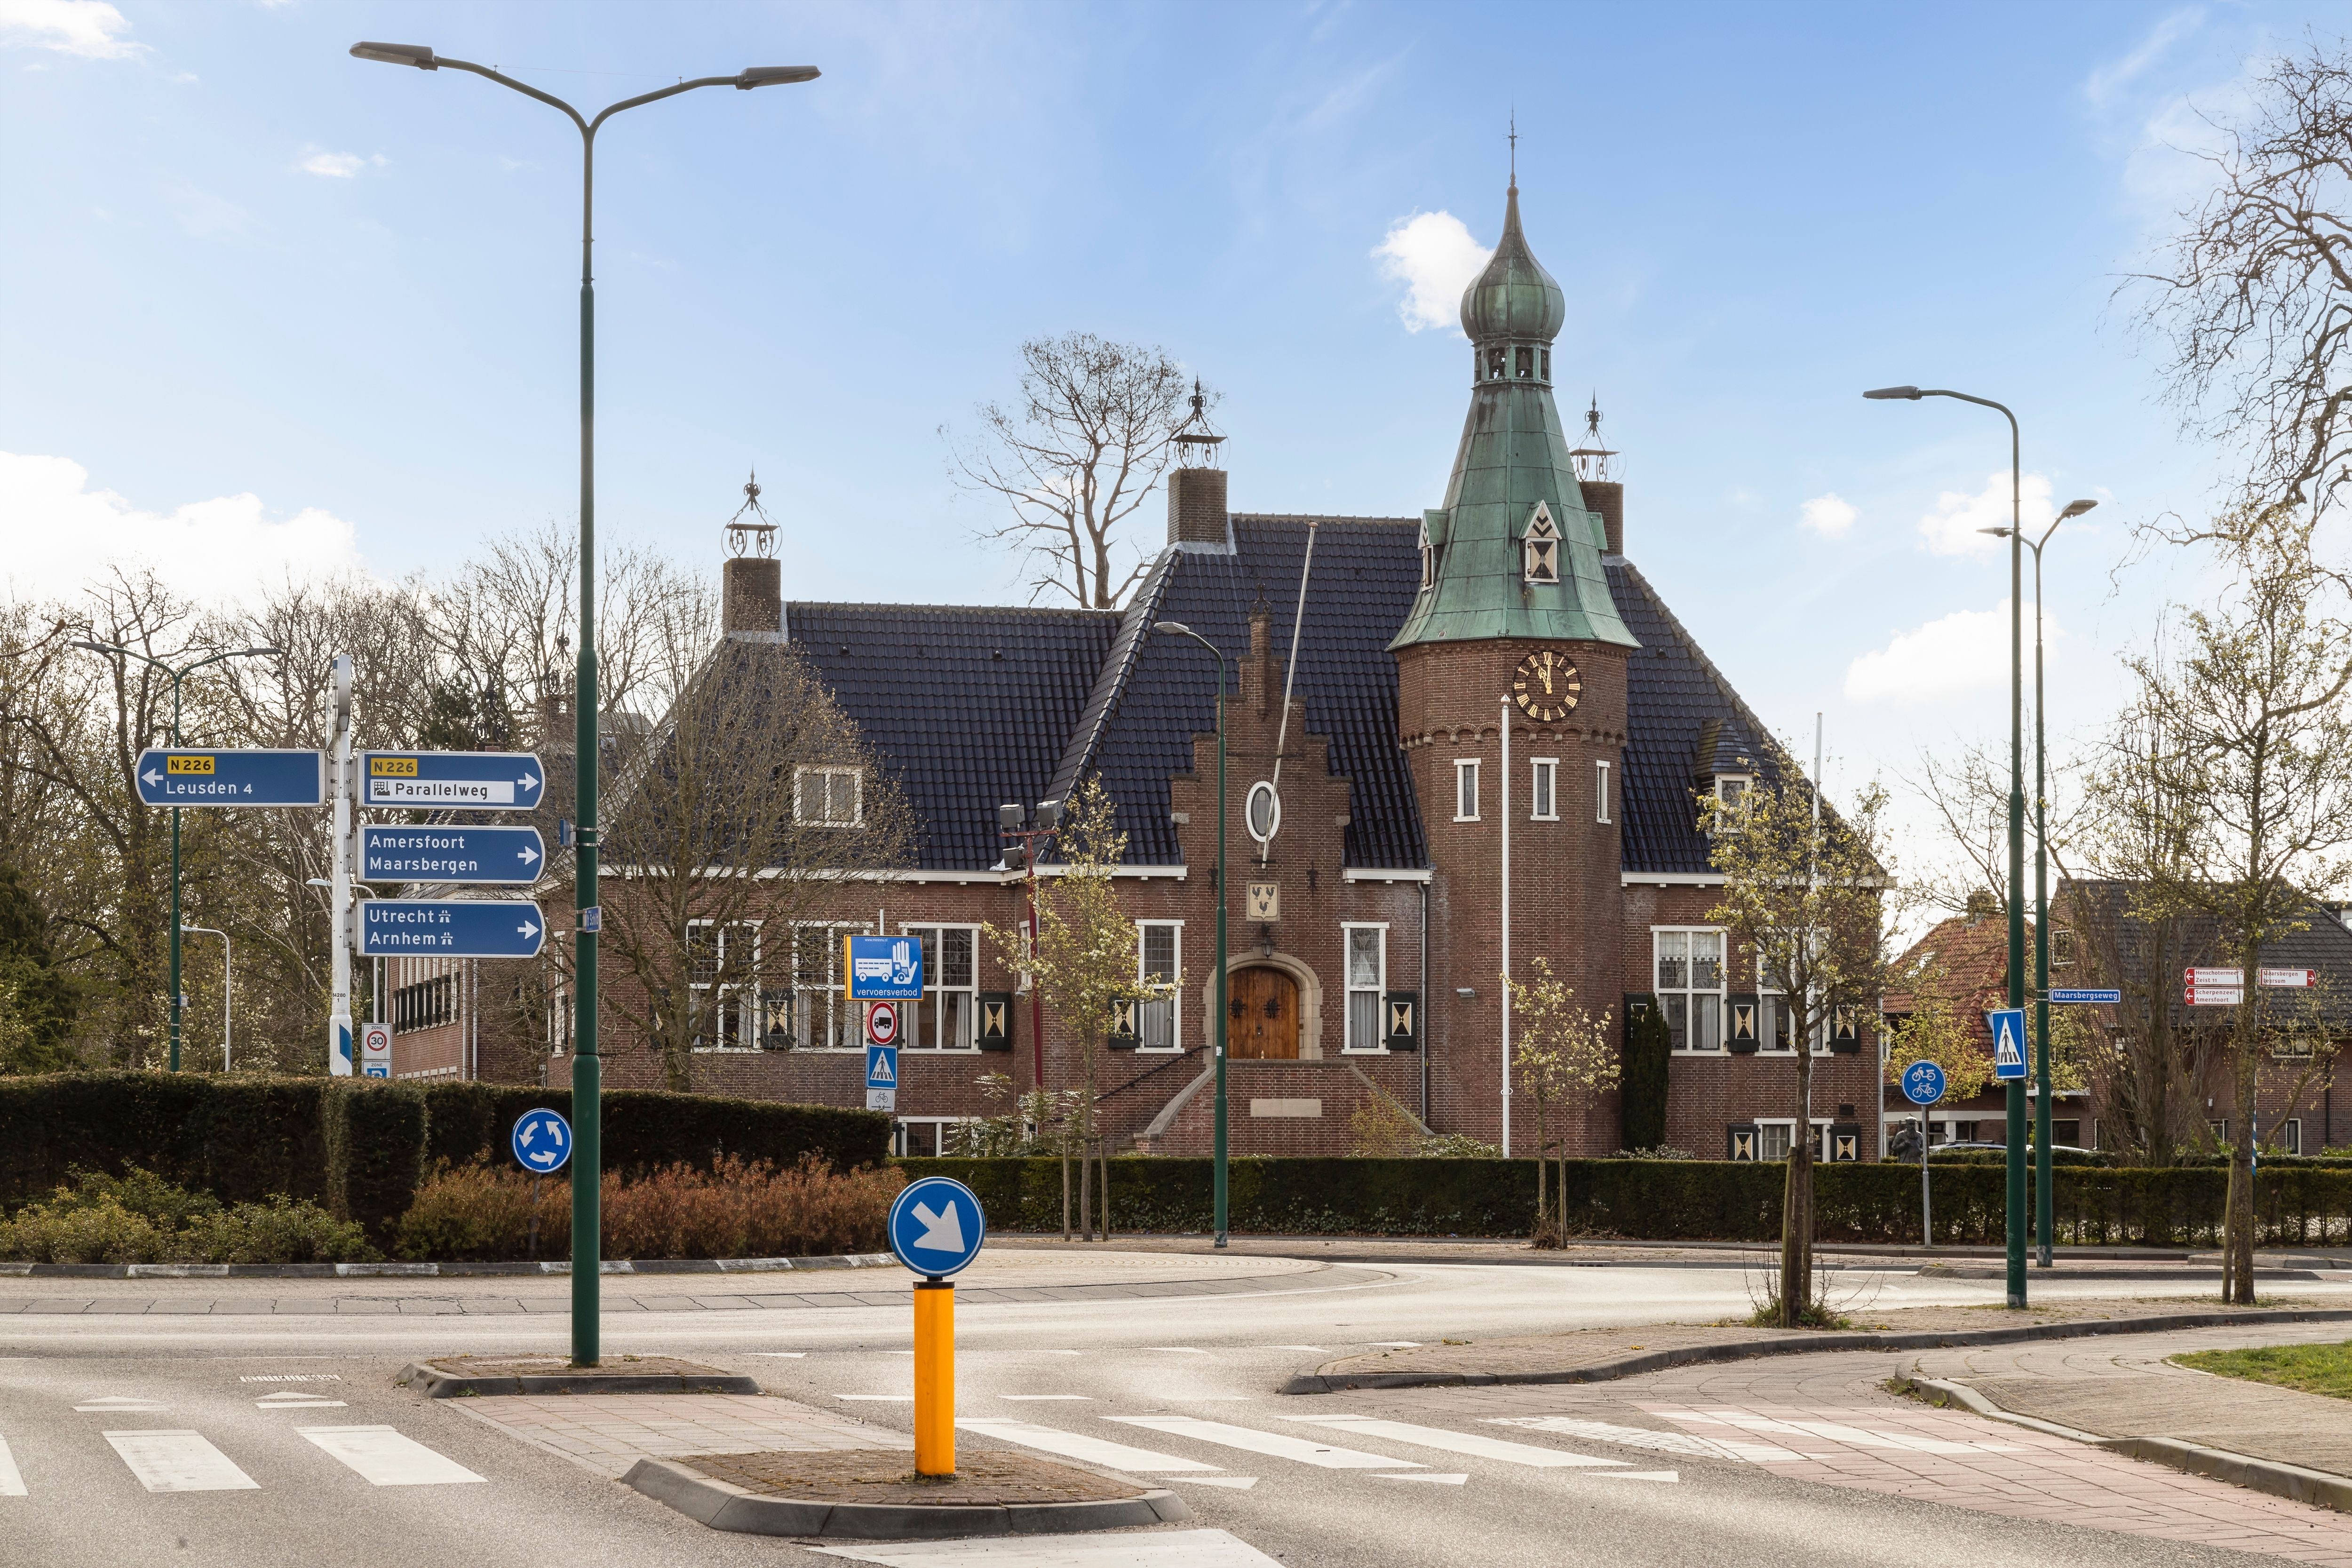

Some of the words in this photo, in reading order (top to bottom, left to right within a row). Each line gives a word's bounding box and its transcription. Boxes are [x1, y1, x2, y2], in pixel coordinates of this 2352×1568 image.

[171, 760, 179, 770] N
[183, 760, 211, 771] 226
[374, 762, 383, 772] N
[386, 762, 414, 773] 226
[167, 781, 237, 794] Leusden
[243, 783, 253, 794] 4
[396, 783, 488, 800] Parallelweg
[370, 835, 465, 849] Amersfoort
[370, 857, 477, 875] Maarsbergen
[370, 909, 434, 923] Utrecht
[369, 931, 436, 945] Arnhem
[857, 988, 917, 996] vervoersverbod
[2054, 992, 2118, 1001] Maarsbergseweg
